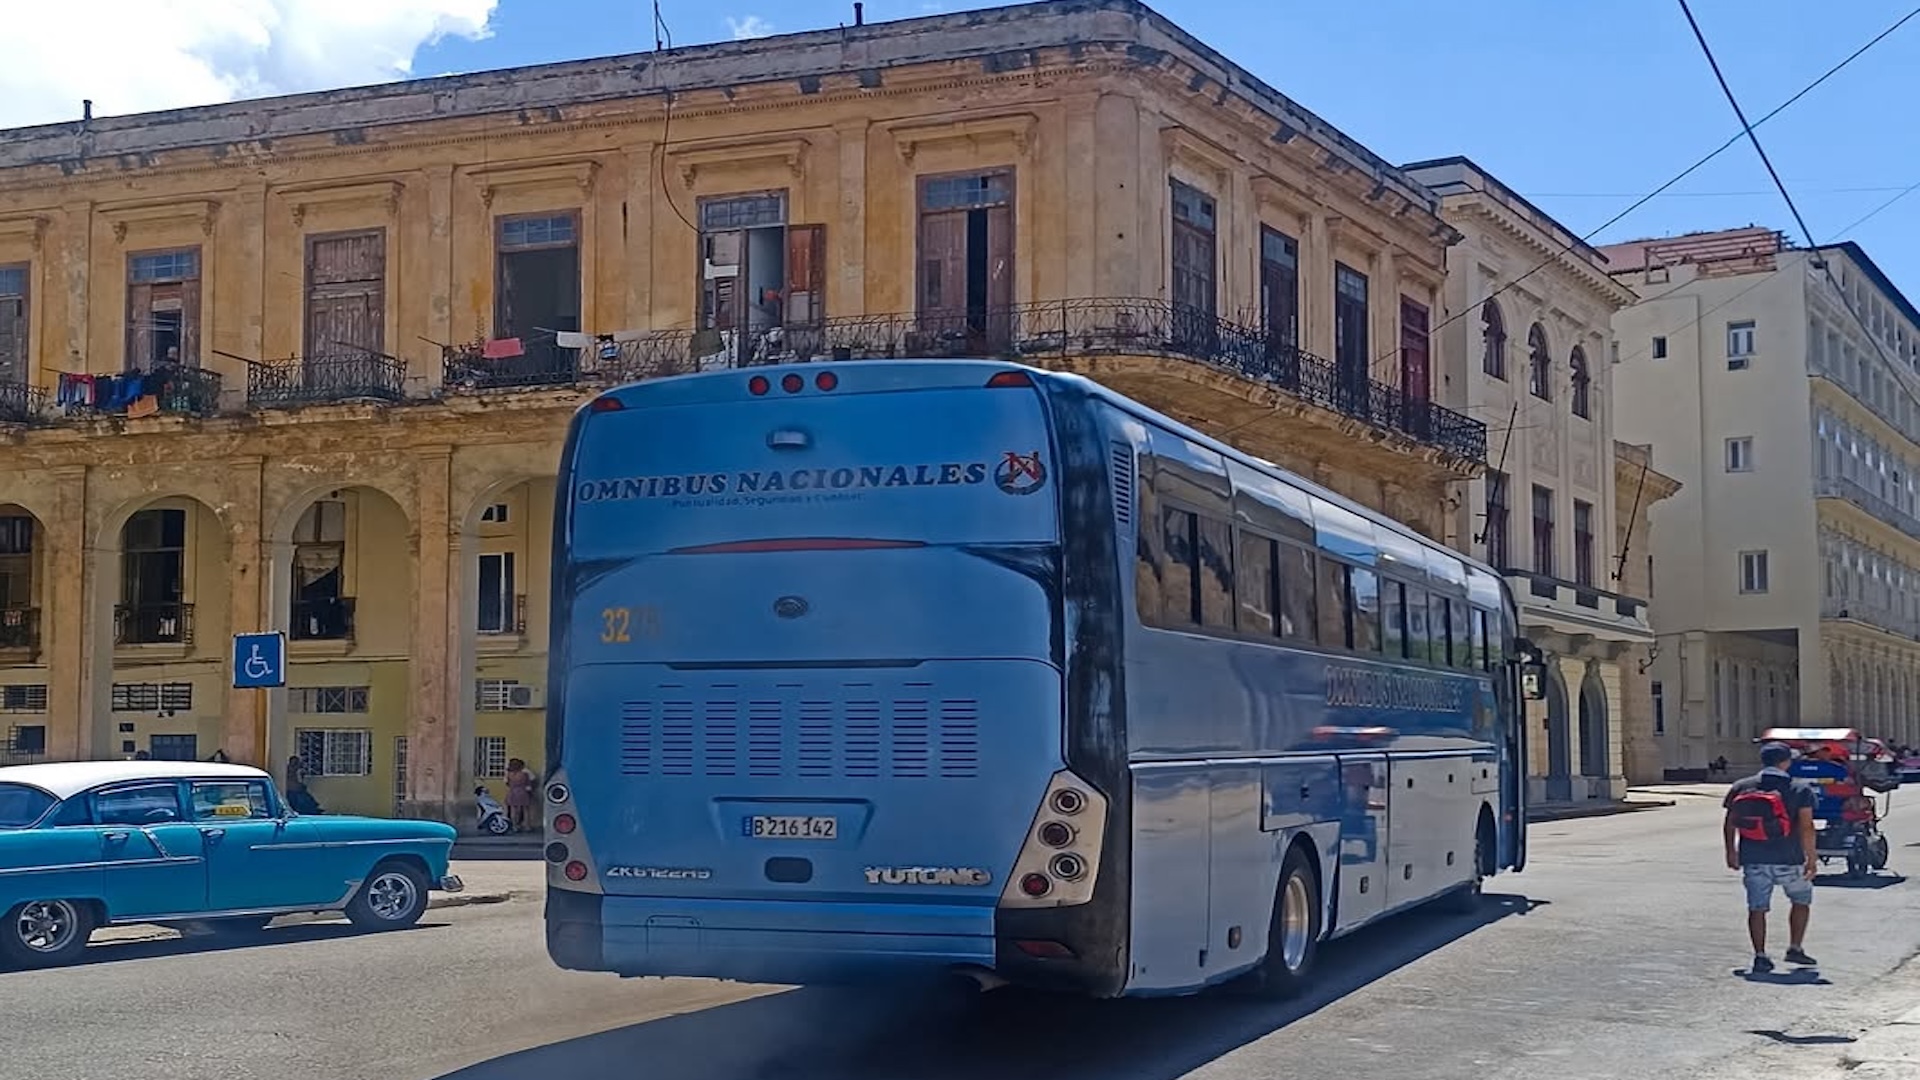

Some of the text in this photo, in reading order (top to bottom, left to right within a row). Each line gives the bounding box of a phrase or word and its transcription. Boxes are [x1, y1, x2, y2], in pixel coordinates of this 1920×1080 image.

[579, 463, 986, 501] OMNIBUS NACIONALES
[864, 866, 991, 886] YUTONG
